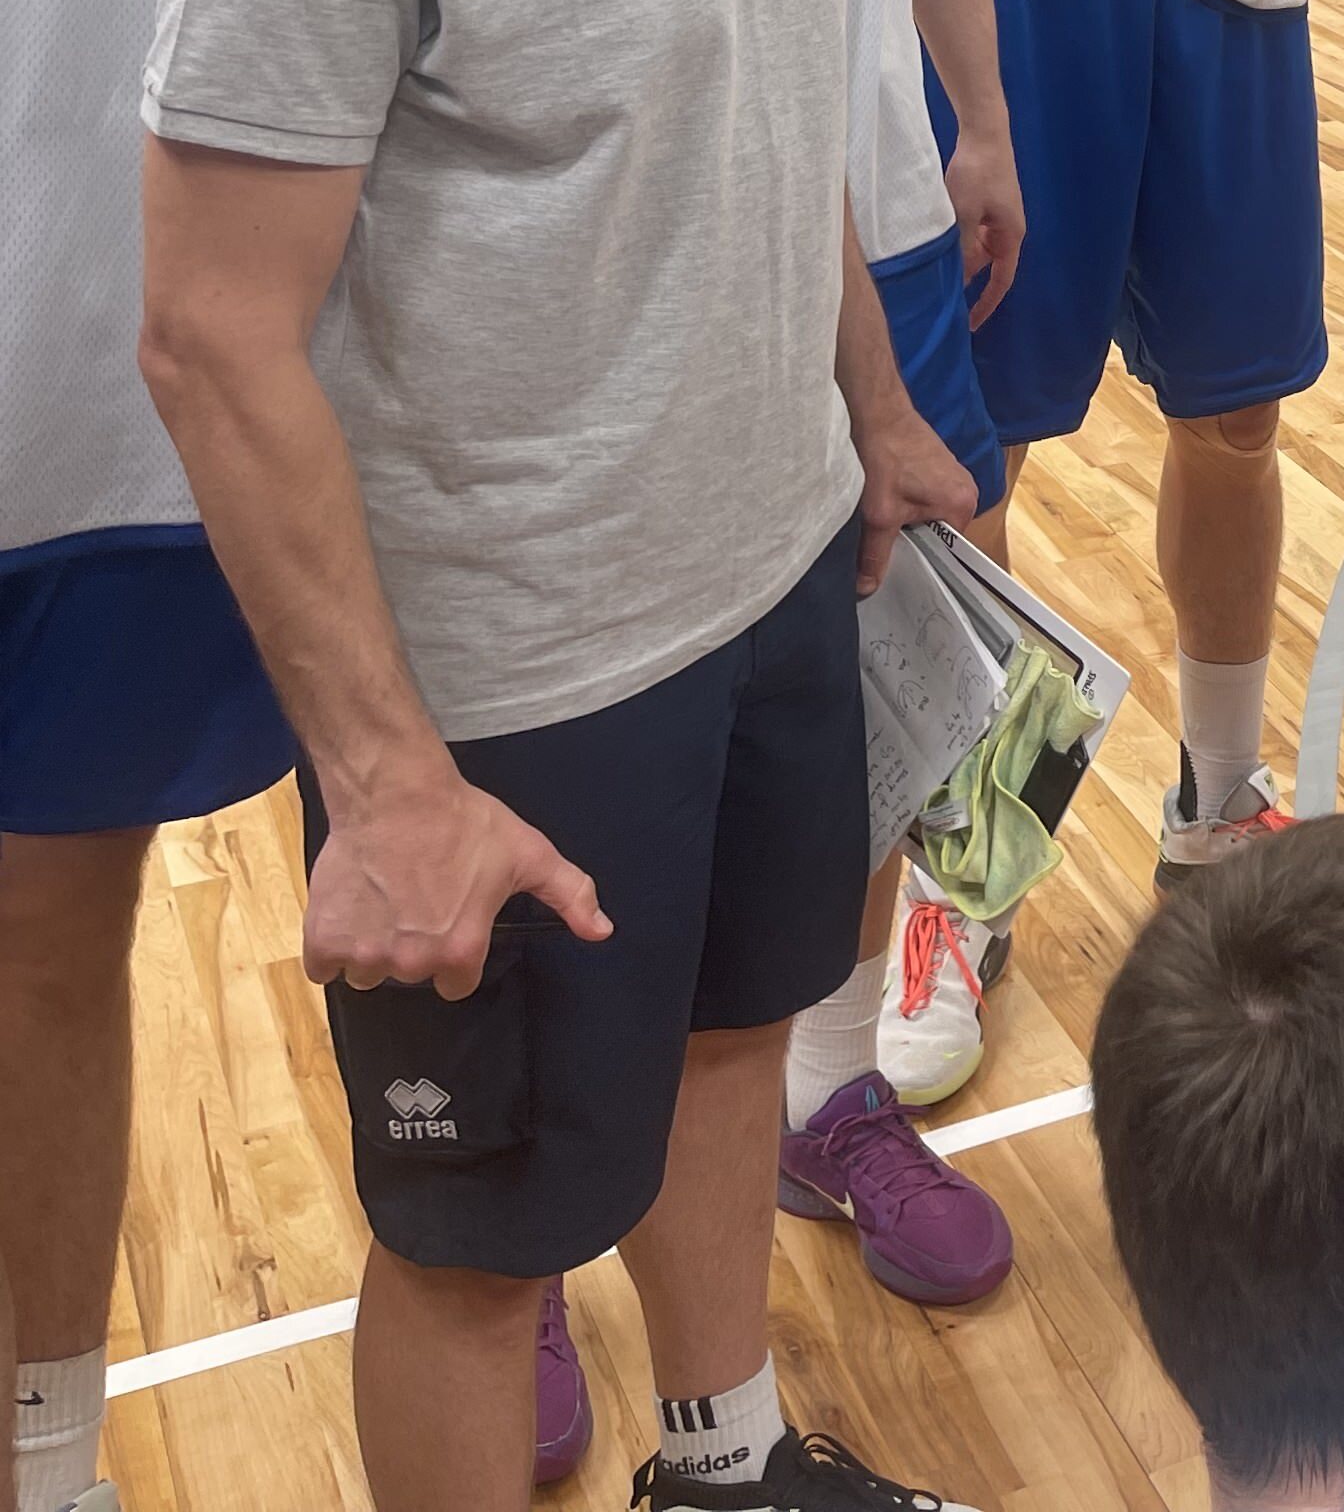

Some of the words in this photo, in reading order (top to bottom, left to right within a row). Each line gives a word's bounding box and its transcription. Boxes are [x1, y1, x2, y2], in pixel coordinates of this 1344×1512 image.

[924, 519, 958, 548] SPAL
[388, 1119, 459, 1140] errea
[661, 1446, 750, 1476] adidas
